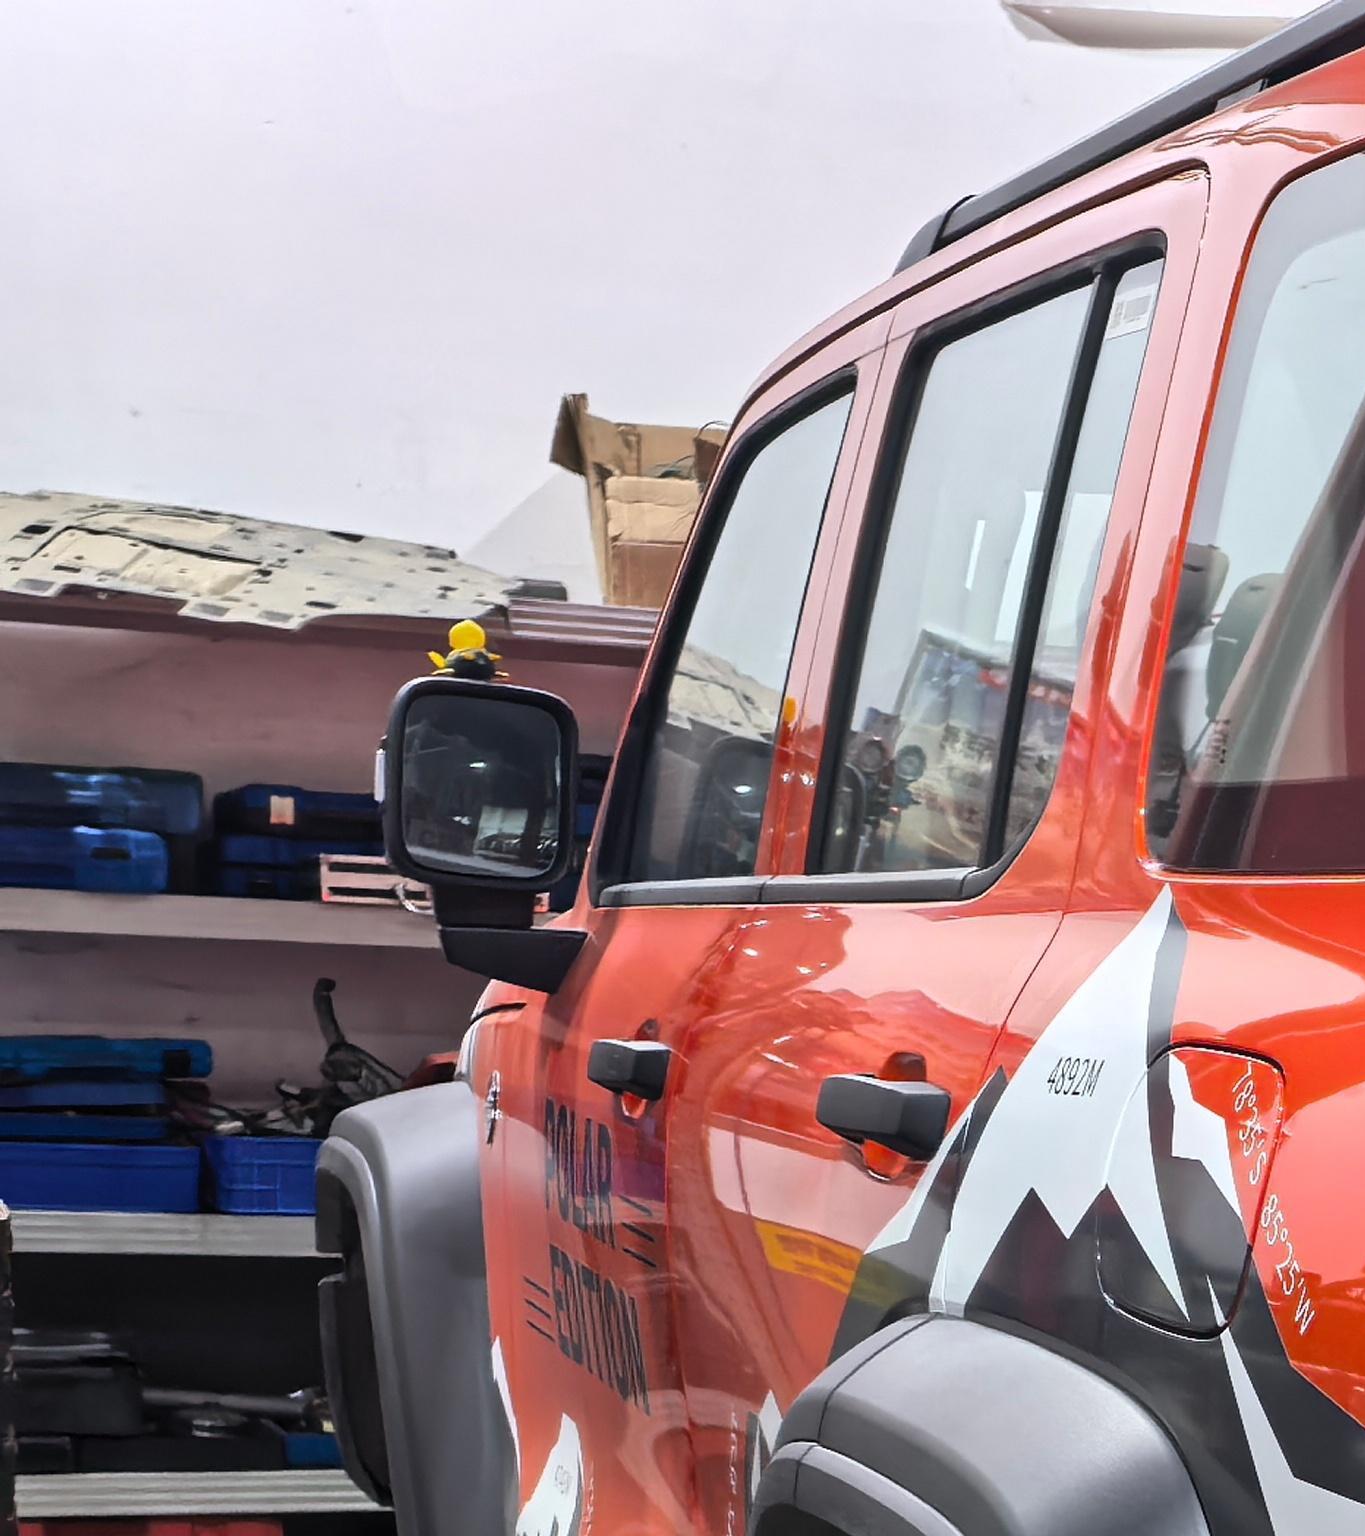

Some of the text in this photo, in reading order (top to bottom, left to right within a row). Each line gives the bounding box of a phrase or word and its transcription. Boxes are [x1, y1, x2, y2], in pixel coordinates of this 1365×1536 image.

[1047, 1056, 1105, 1097] 4892M
[545, 1096, 615, 1249] POLAR
[550, 1242, 650, 1417] EDITION
